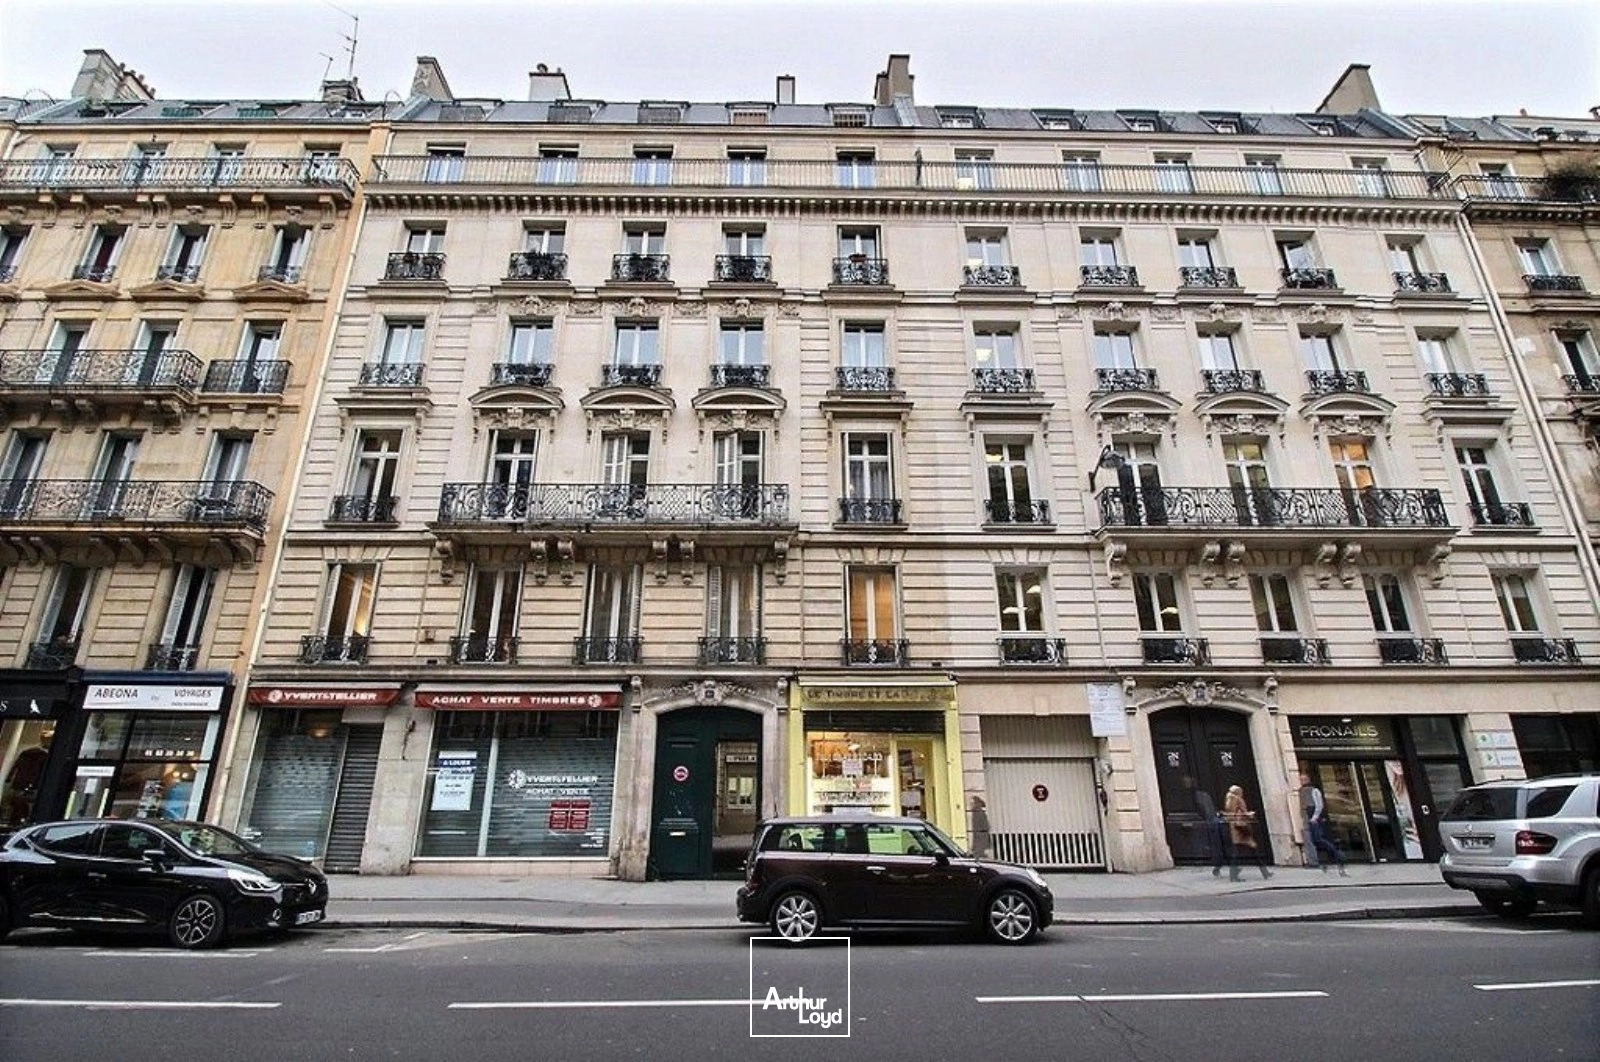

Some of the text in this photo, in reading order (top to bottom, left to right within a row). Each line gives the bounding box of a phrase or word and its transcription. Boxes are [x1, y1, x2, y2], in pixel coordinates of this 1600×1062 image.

[94, 688, 138, 699] ABEONA
[173, 688, 212, 698] VOYAGES
[432, 695, 586, 704] ACHAT VENTE TIMBRES
[1299, 725, 1379, 737] PRONAILS
[526, 787, 589, 796] ACHAT VENTE
